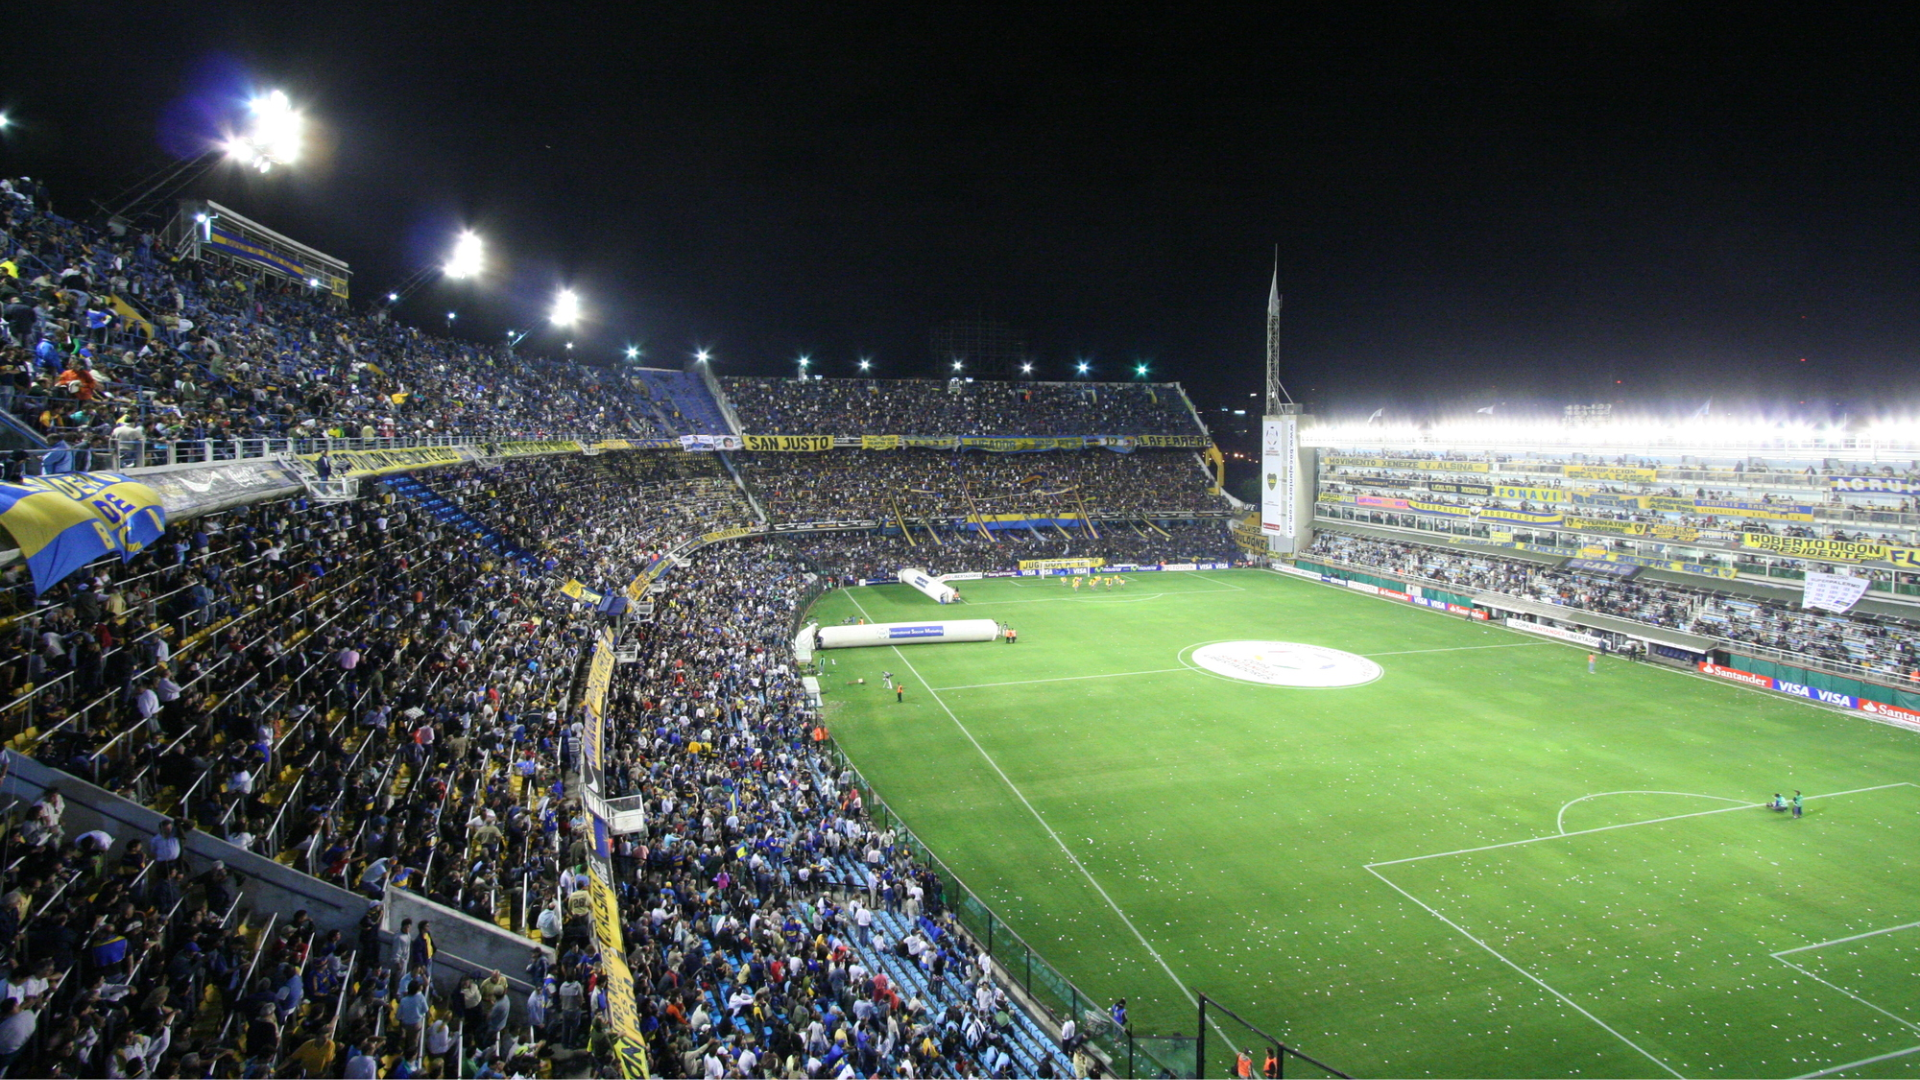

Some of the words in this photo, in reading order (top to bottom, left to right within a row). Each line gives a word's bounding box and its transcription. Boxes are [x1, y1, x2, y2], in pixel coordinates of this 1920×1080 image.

[750, 437, 779, 450] SAN
[784, 436, 829, 450] JUSTO
[1140, 435, 1212, 447] LAFERRERE
[1329, 458, 1376, 466] MOVIMIENTO
[1382, 460, 1419, 469] XENEIZE
[1581, 466, 1636, 474] AGRUPACION
[1499, 488, 1557, 501] FONAVI
[92, 493, 136, 524] DE
[1415, 503, 1470, 515] AGRUPACION
[1751, 533, 1827, 549] ROBERTO
[1829, 540, 1881, 555] DIGON
[1759, 543, 1864, 560] PRESIDENTE
[1023, 560, 1063, 570] JUGDOR
[1616, 554, 1671, 569] SIEMPRE
[1384, 589, 1409, 601] Santander
[1413, 596, 1428, 606] VISA
[1431, 599, 1446, 609] VISA
[1515, 621, 1530, 630] COPA
[1530, 624, 1565, 637] SANTANDER
[1714, 666, 1767, 686] Santander
[1778, 681, 1811, 697] VISA
[1817, 689, 1851, 707] VISA
